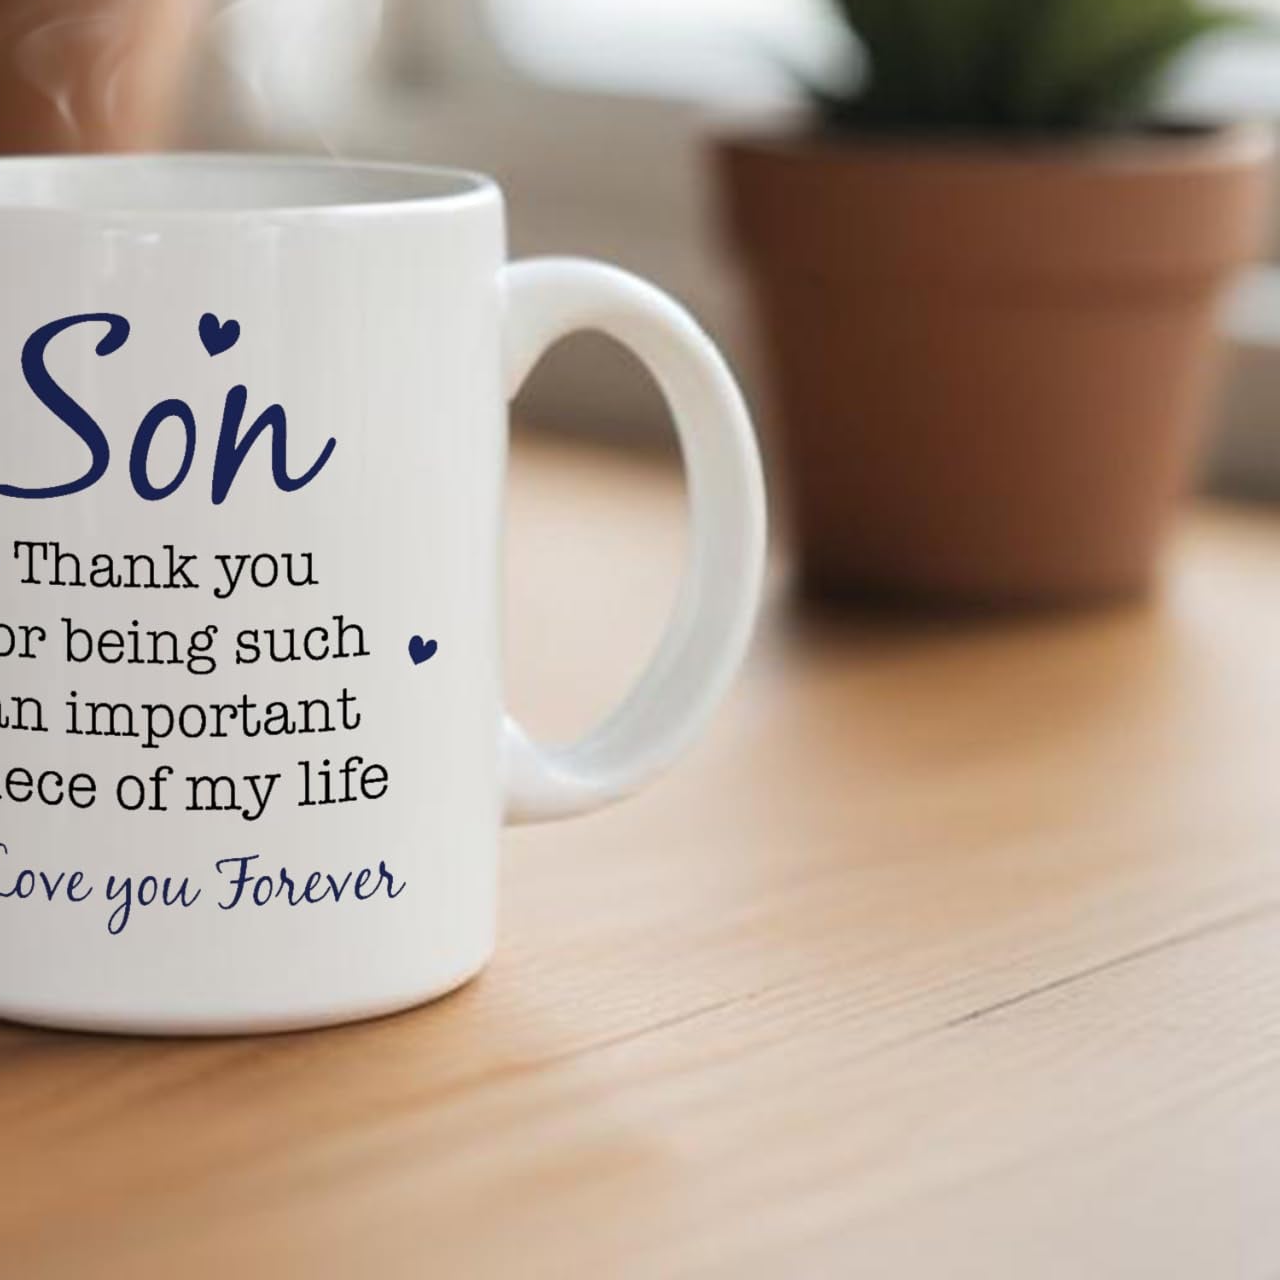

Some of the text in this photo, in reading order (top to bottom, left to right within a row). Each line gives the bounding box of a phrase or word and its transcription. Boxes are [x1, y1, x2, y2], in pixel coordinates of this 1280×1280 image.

[13, 540, 320, 599] Thank you
[60, 616, 219, 676] being
[235, 614, 371, 665] such
[65, 687, 362, 749] important
[116, 765, 174, 812] of
[185, 773, 282, 822] my
[297, 755, 389, 807] life
[105, 875, 202, 935] you
[215, 854, 407, 910] Forever
